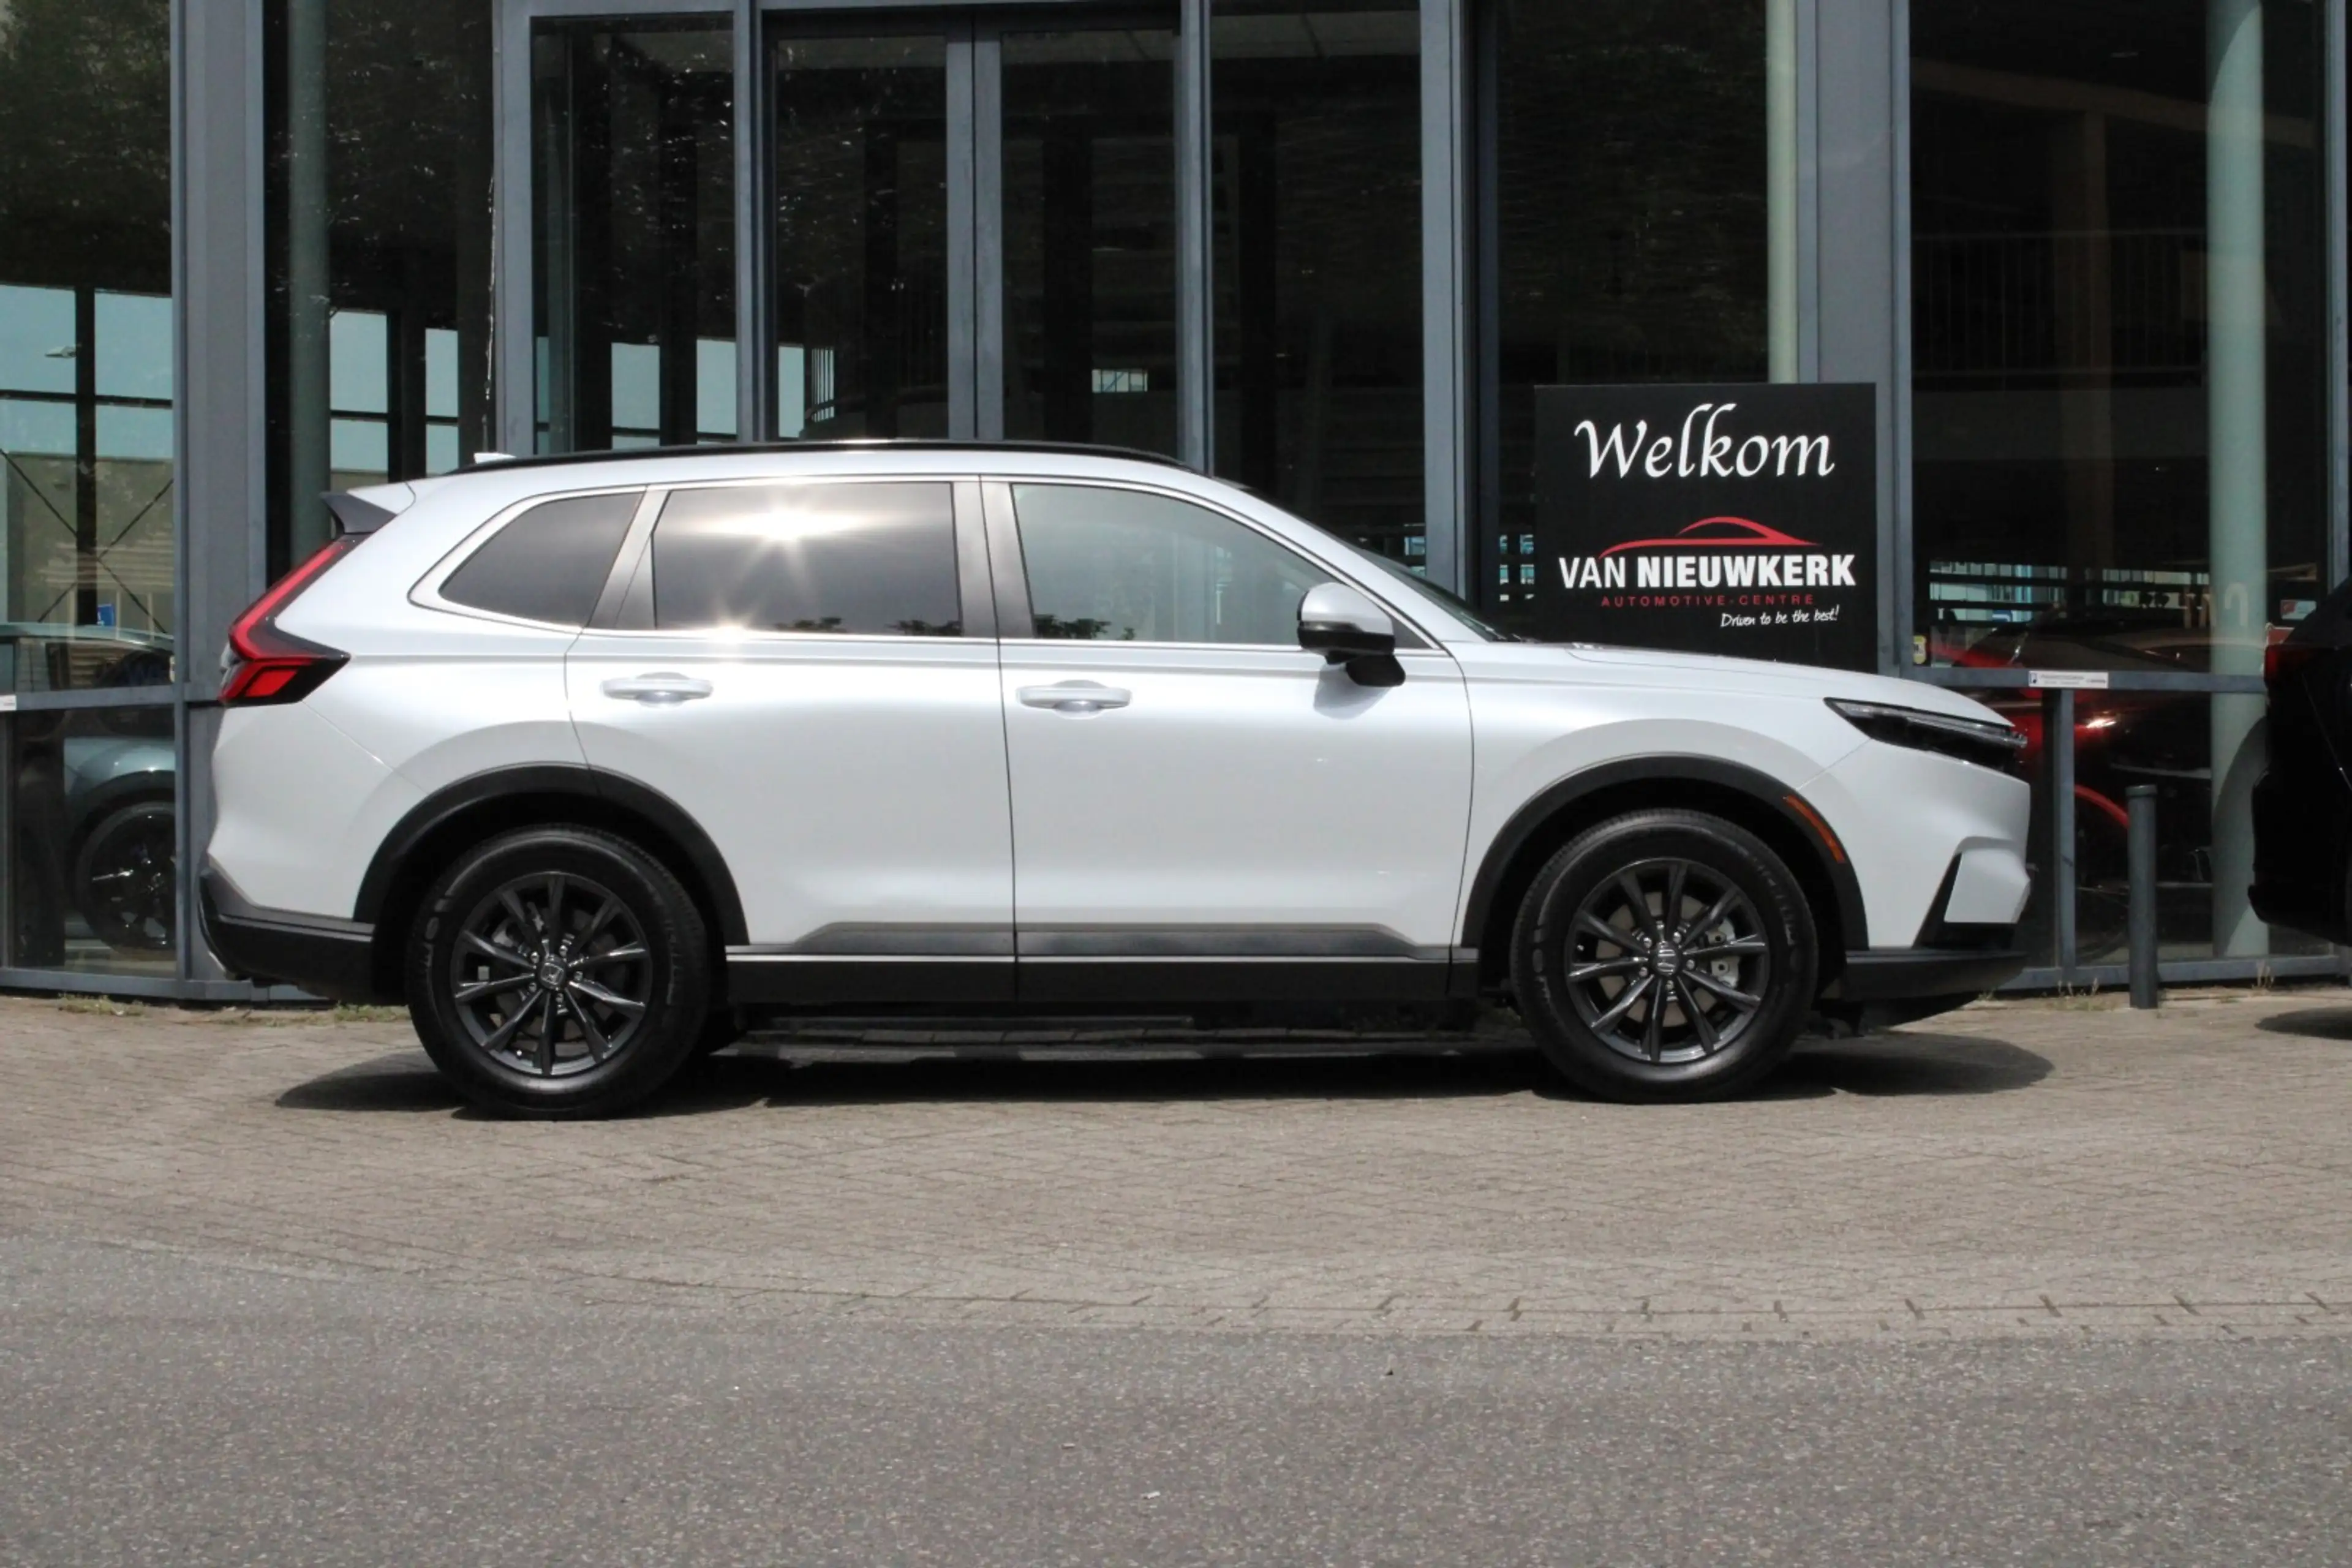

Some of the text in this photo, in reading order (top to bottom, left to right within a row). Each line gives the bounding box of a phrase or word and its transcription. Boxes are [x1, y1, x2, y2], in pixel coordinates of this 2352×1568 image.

[1574, 402, 1835, 478] Welkom
[1558, 554, 1856, 589] VAN NIEUWKERK
[1720, 604, 1840, 628] Driven to be the best!
